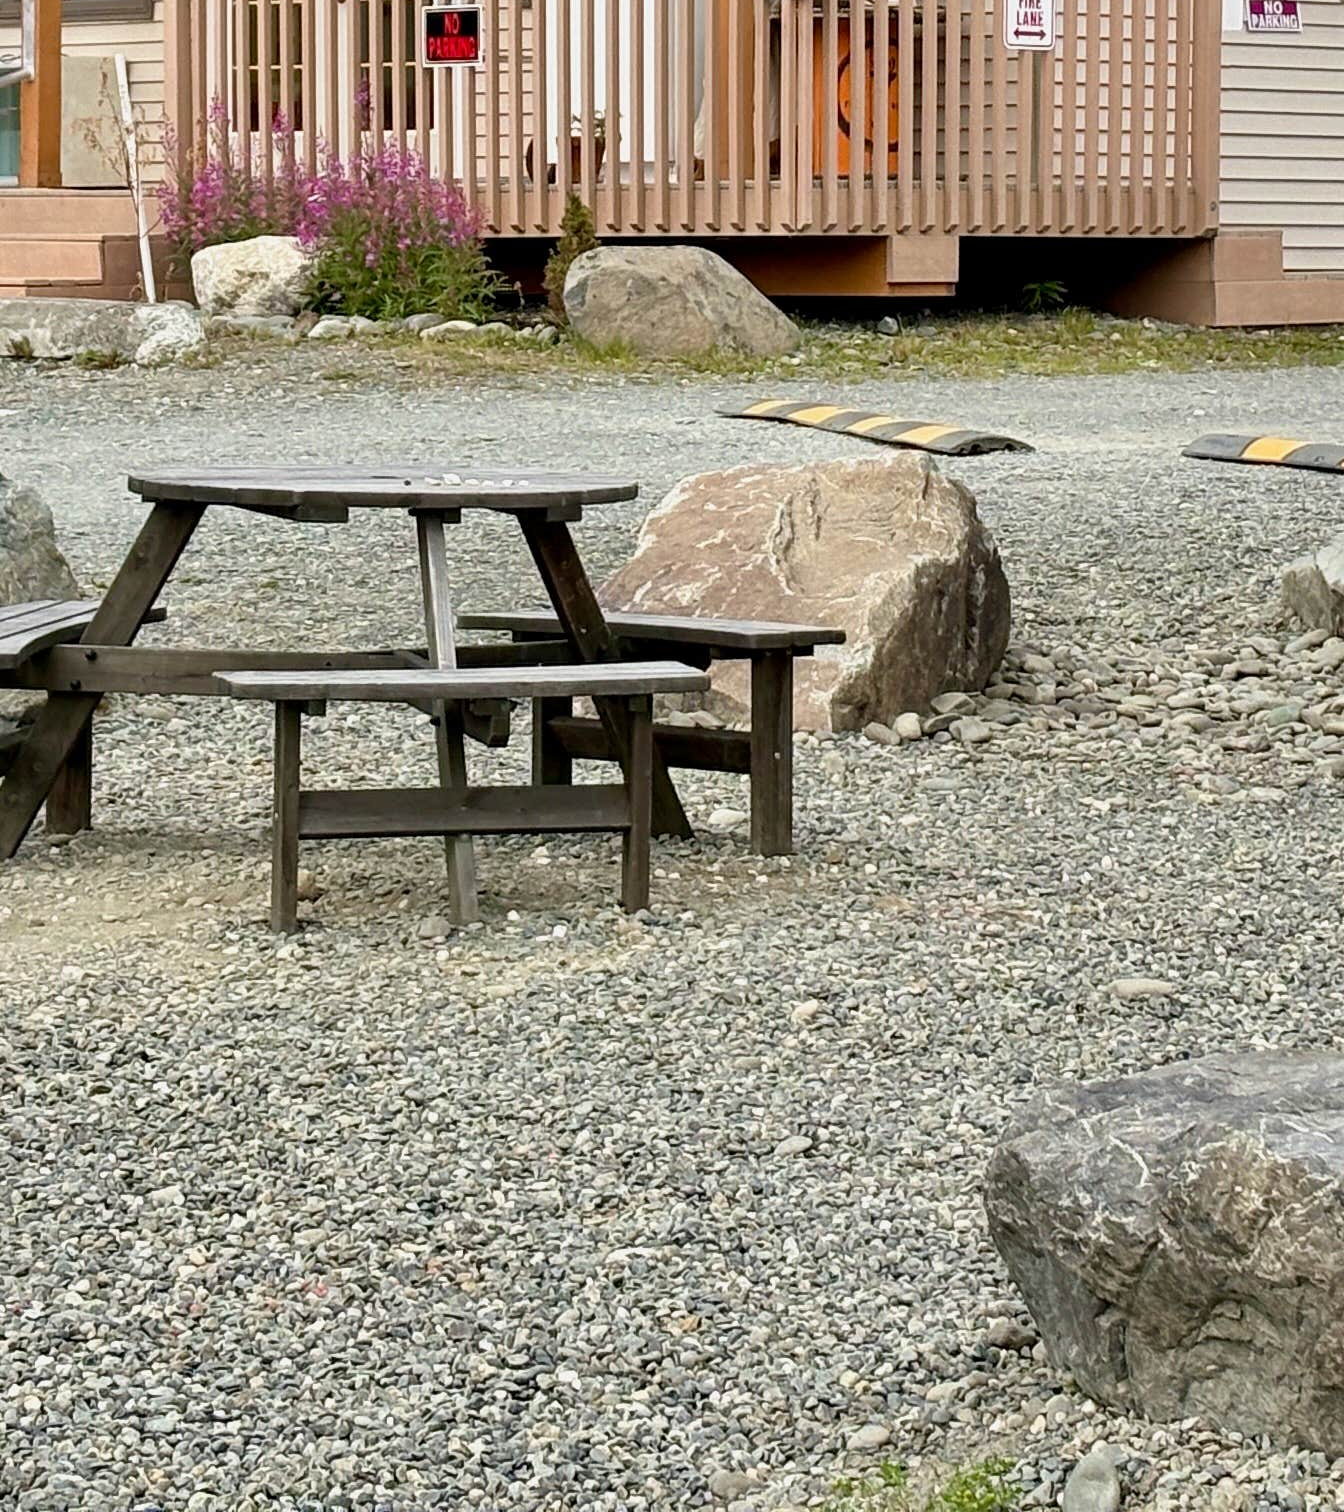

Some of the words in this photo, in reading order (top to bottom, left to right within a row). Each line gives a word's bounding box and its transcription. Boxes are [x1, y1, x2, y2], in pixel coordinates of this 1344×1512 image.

[1263, 0, 1284, 14] NO
[444, 13, 461, 34] NO
[1016, 11, 1044, 27] LANE
[1251, 14, 1297, 28] PARKING
[428, 36, 476, 59] PARKING
